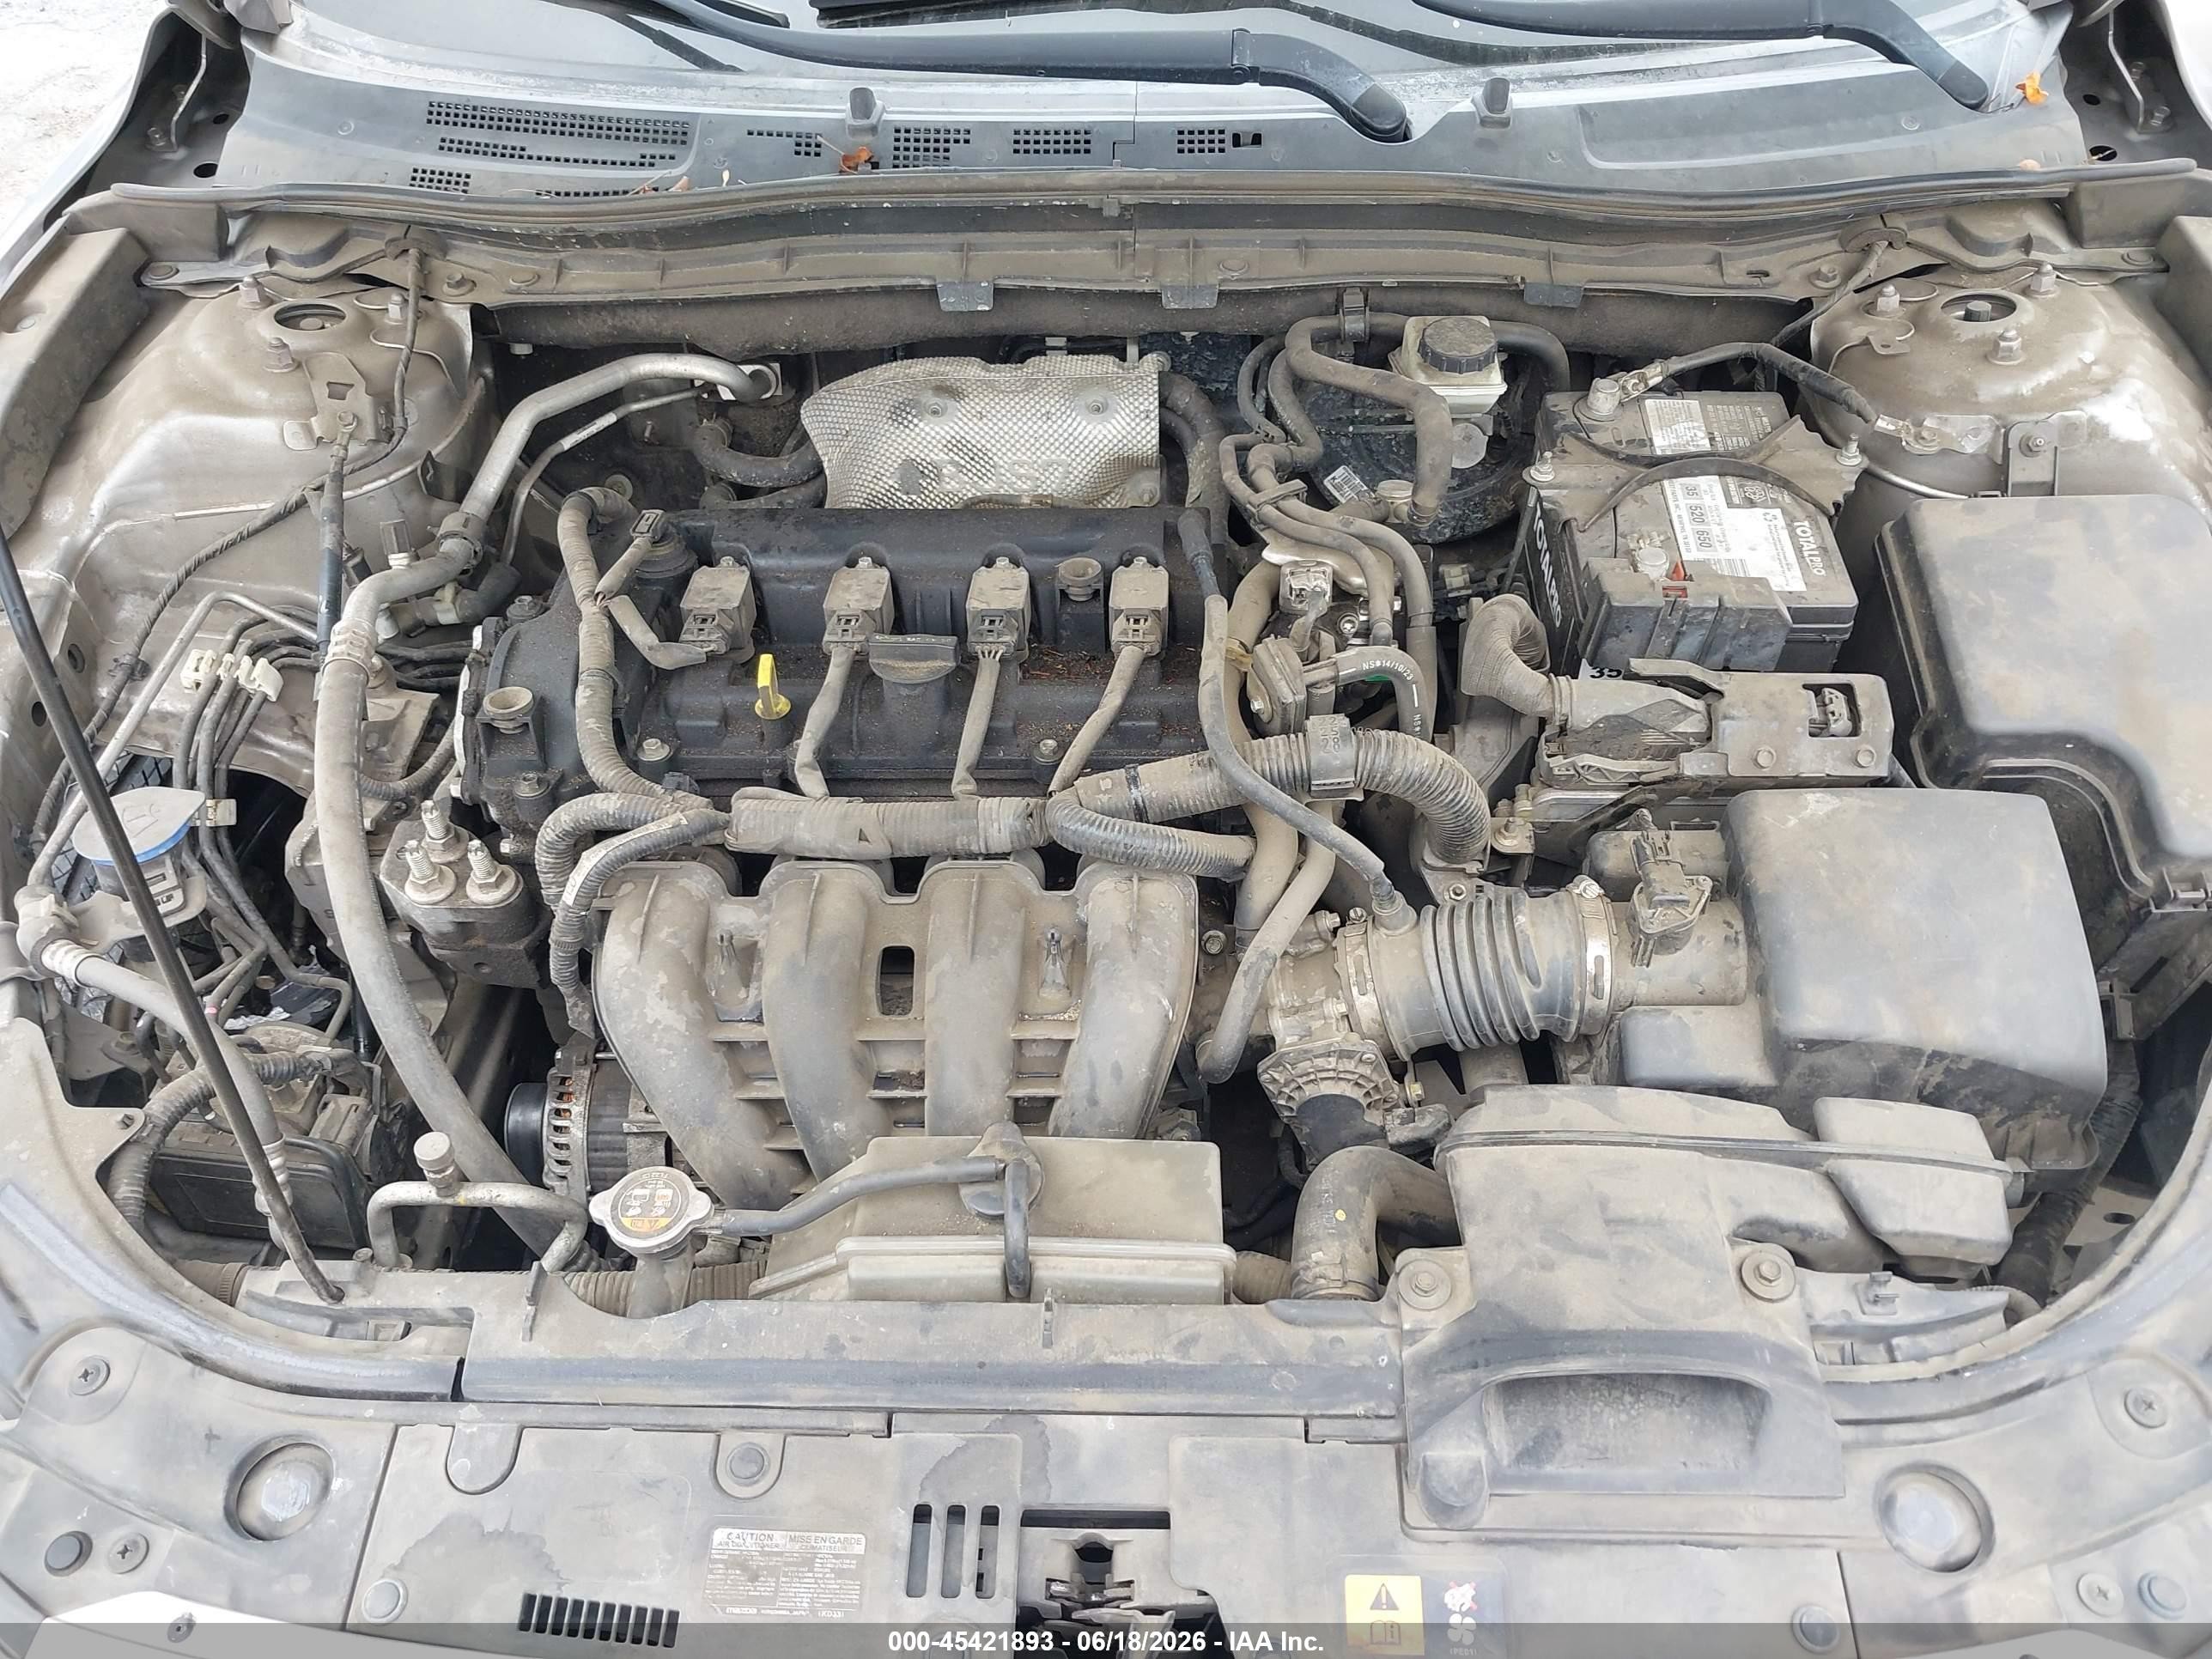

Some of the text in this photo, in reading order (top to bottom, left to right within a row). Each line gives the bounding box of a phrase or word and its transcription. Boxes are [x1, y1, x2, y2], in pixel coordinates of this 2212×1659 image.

[1686, 486, 1699, 496] 35
[1689, 505, 1705, 524] 520
[1696, 530, 1713, 549] 650
[1794, 520, 1827, 576] TOTALPRO
[1534, 501, 1562, 628] TOTALPRO
[726, 1532, 775, 1542] CAUTION
[788, 1534, 862, 1546] MISE EN GARDE
